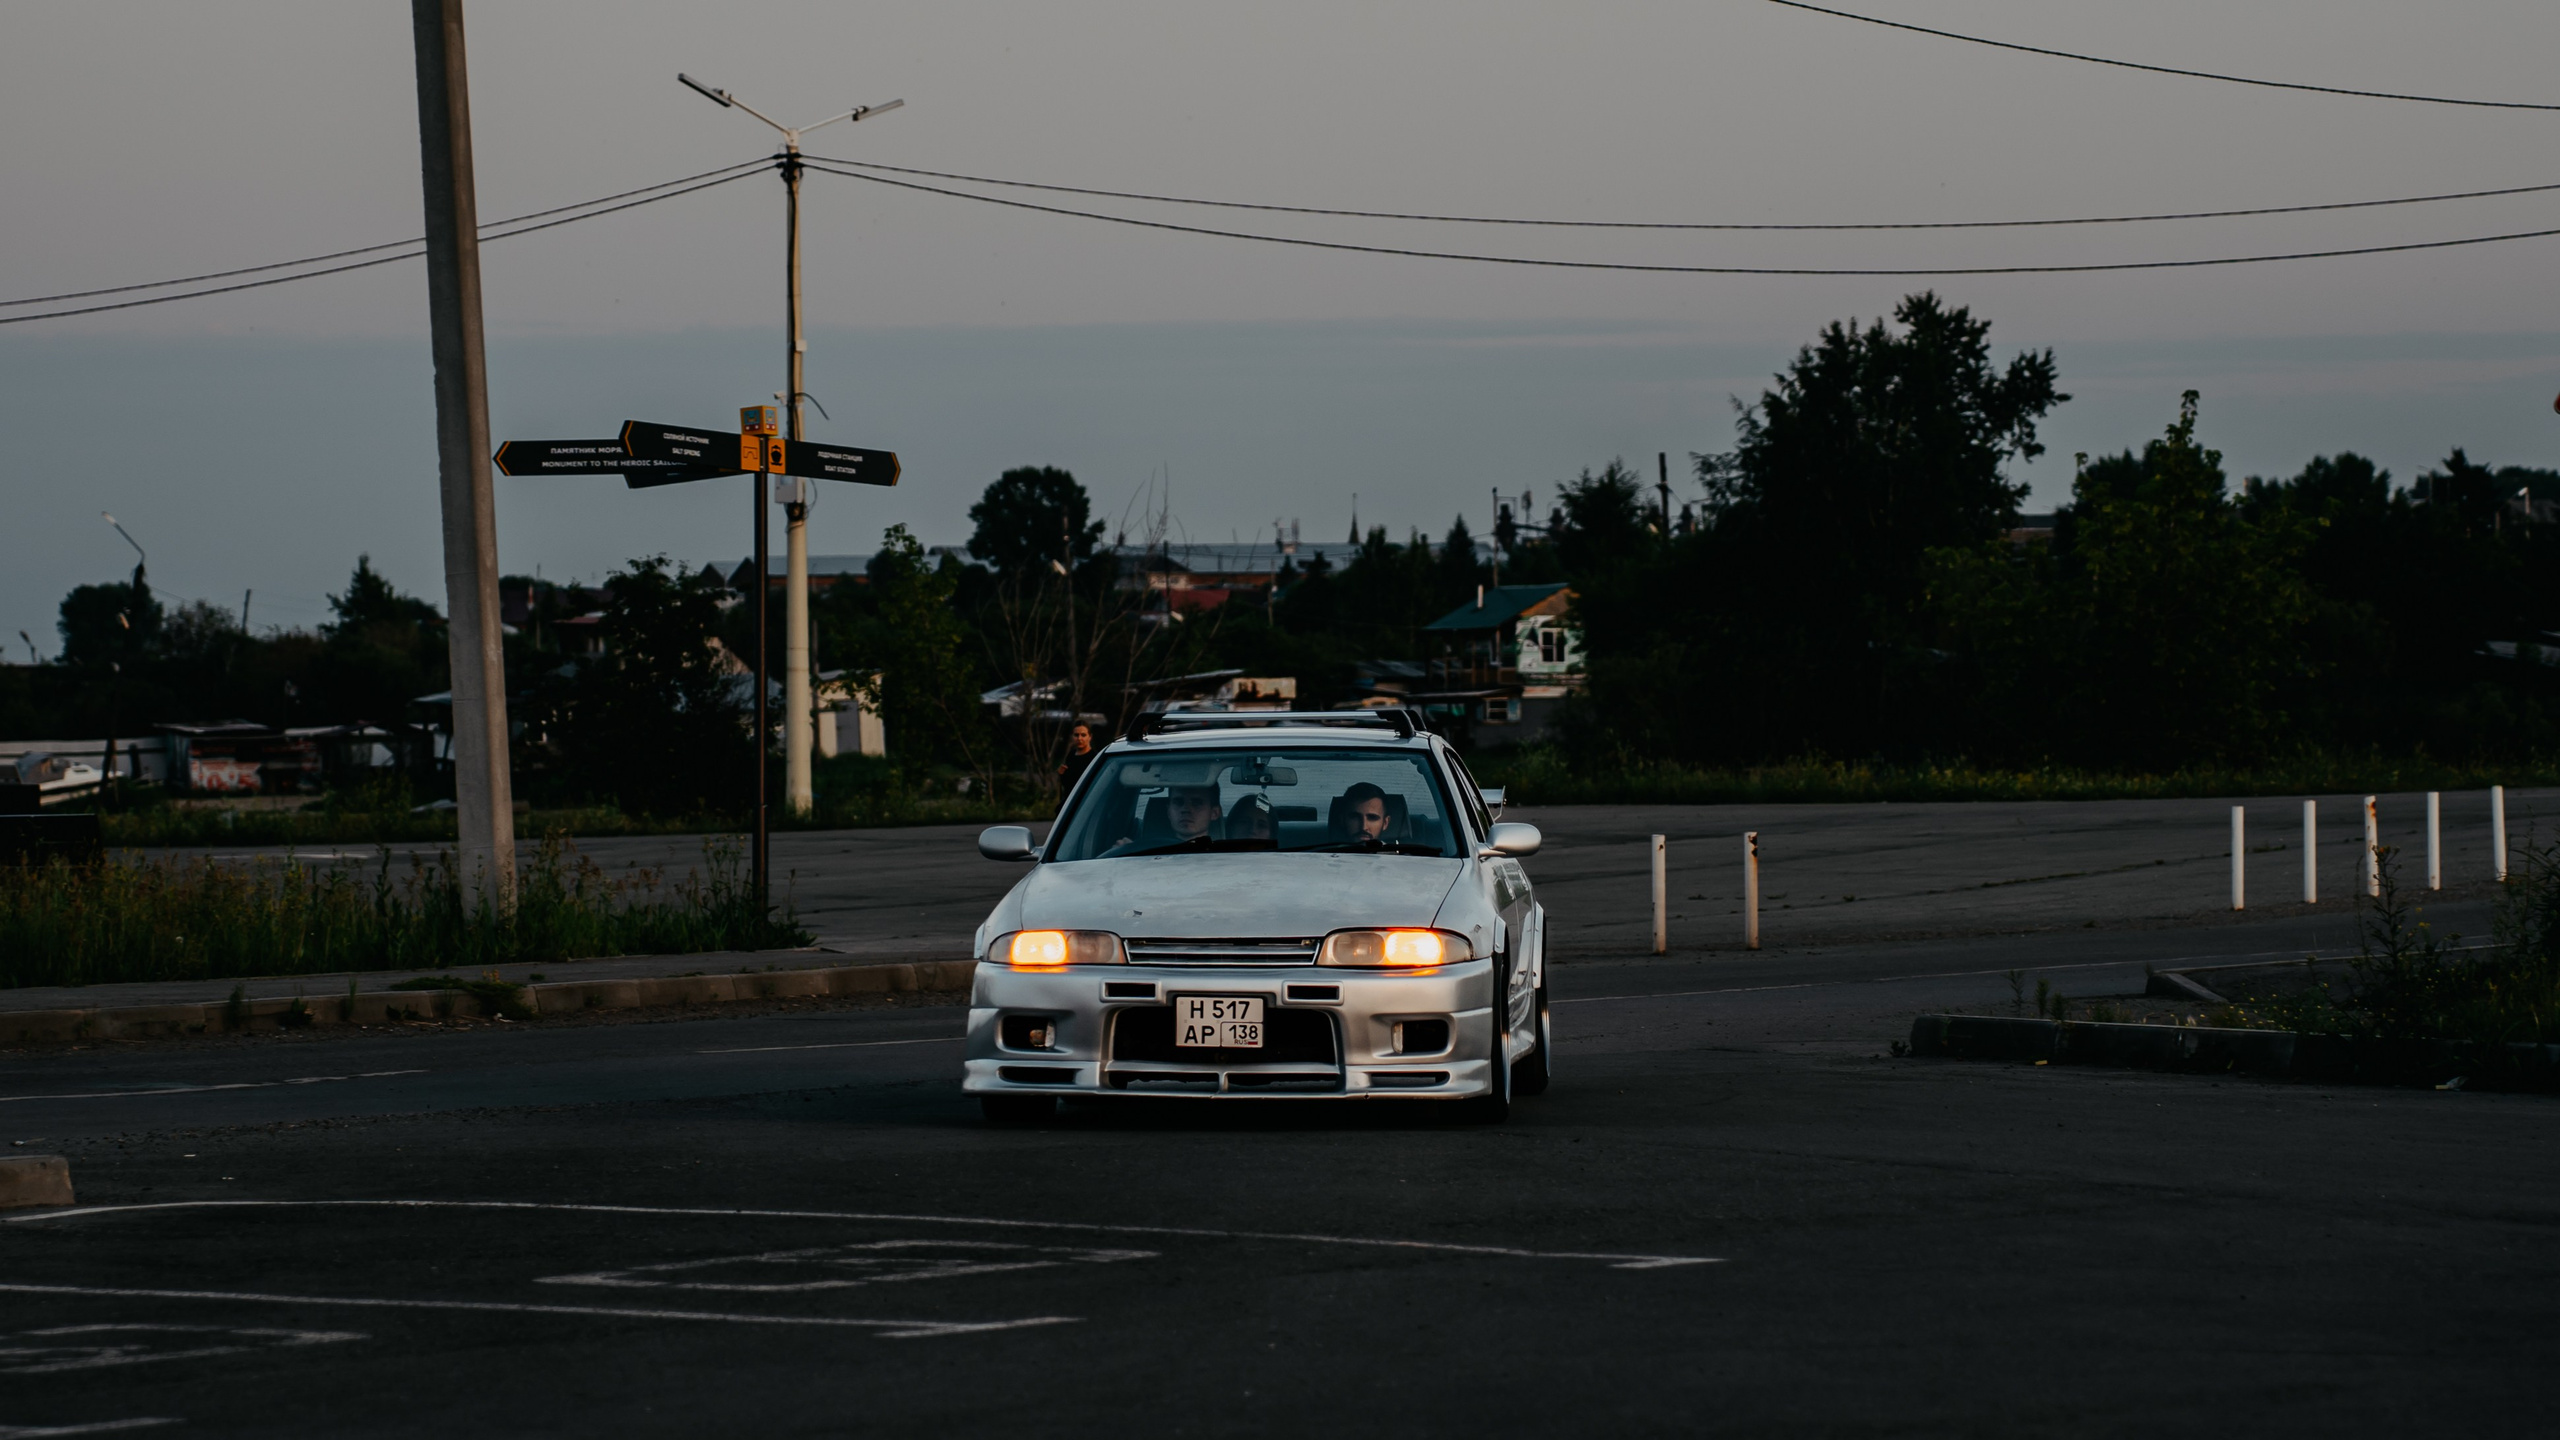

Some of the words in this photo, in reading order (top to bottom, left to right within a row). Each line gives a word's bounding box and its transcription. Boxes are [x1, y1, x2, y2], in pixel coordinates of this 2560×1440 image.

[598, 446, 624, 454] МОРЯ
[620, 459, 651, 467] HEROIC
[1212, 1000, 1250, 1019] 517
[1229, 1024, 1258, 1040] 138
